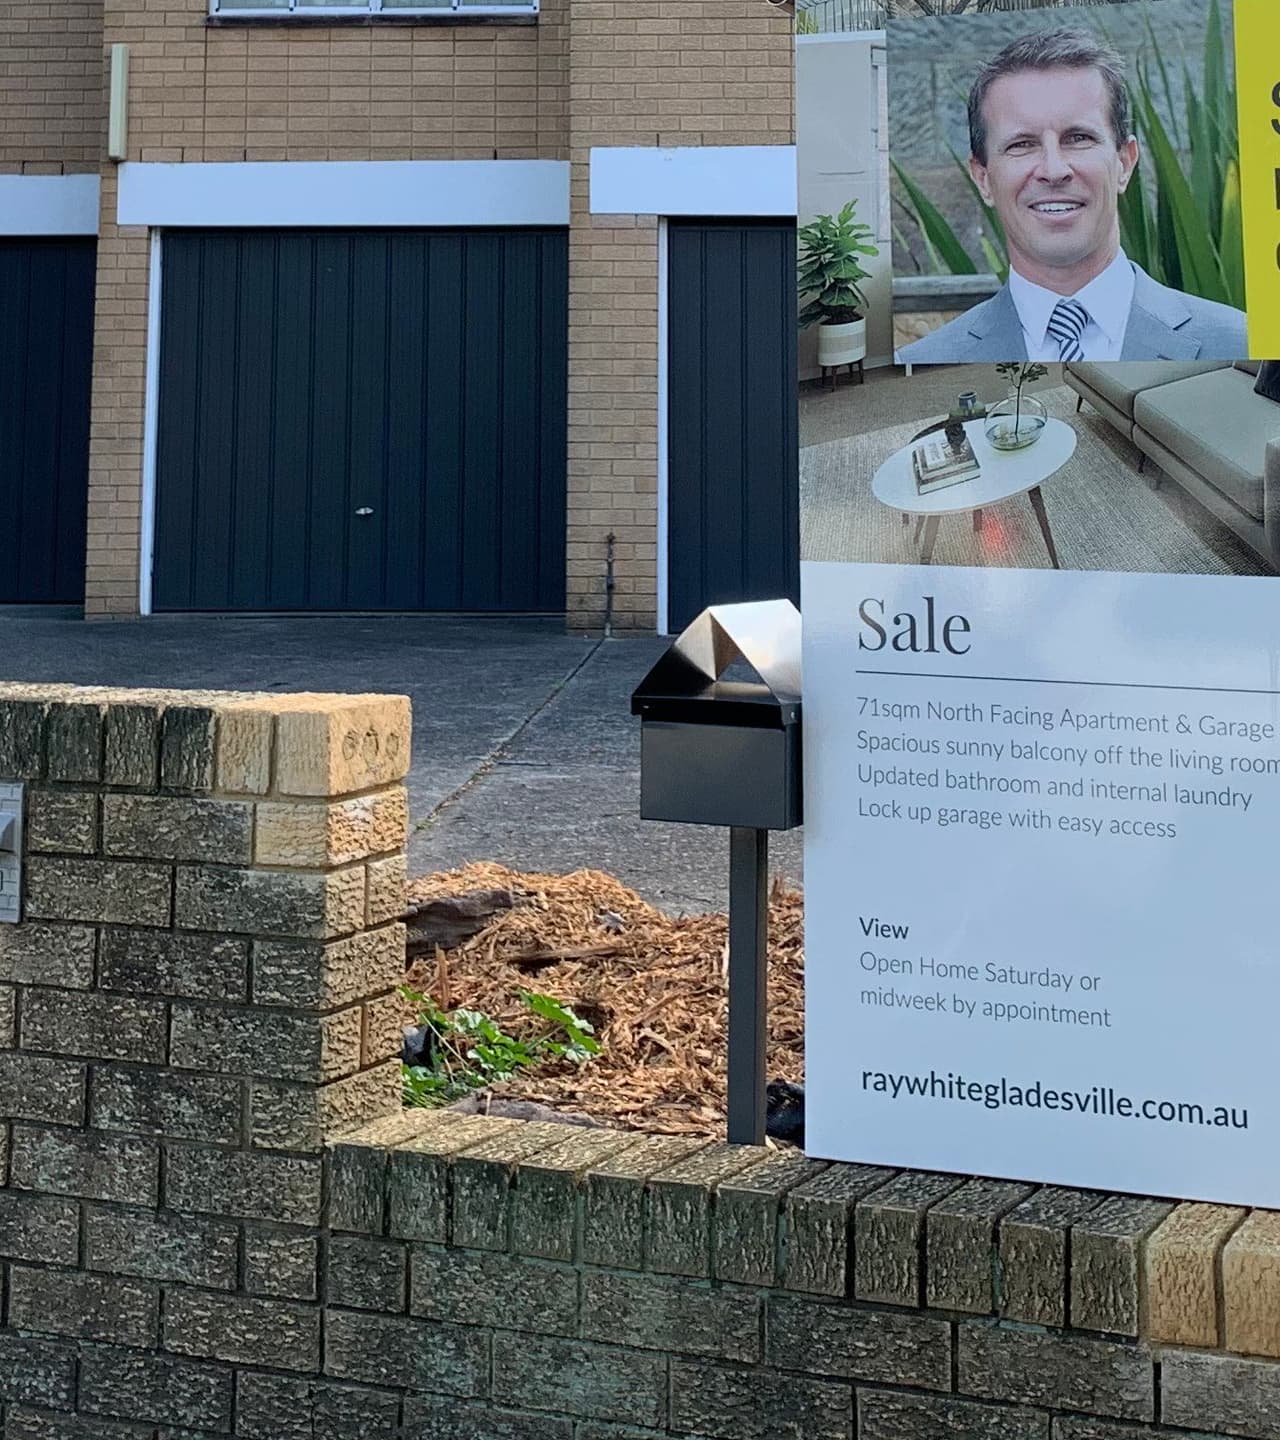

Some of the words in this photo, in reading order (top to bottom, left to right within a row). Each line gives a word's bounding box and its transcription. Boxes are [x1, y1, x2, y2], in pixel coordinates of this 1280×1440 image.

[859, 597, 971, 655] Sale
[857, 696, 920, 722] 71sqm
[927, 701, 983, 722] North
[991, 704, 1054, 731] Facing
[1060, 708, 1168, 733] Apartment
[1176, 714, 1192, 734] &
[1199, 715, 1274, 742] Garage
[857, 730, 940, 754] Spacious
[946, 740, 1004, 761] sunny
[1011, 739, 1087, 766] balcony
[1094, 745, 1123, 764] off
[1130, 746, 1163, 767] the
[1170, 748, 1224, 775] living
[858, 764, 939, 787] Updated
[946, 769, 1040, 793] bathroom
[1047, 778, 1083, 797] and
[1091, 778, 1167, 802] internal
[1175, 784, 1252, 811] laundry
[859, 797, 902, 818] Lock
[908, 806, 931, 824] up
[938, 808, 1002, 829] garage
[1008, 809, 1051, 829] with
[1058, 816, 1103, 837] easy
[1110, 820, 1176, 838] access
[859, 917, 909, 939] View
[860, 951, 912, 975] Open
[920, 957, 979, 981] Home
[985, 962, 1073, 992] Saturday
[1080, 976, 1101, 991] or
[861, 987, 947, 1012] midweek
[953, 993, 976, 1018] by
[983, 1001, 1111, 1027] appointment
[863, 1071, 1248, 1128] raywhitegladesville.com.au
